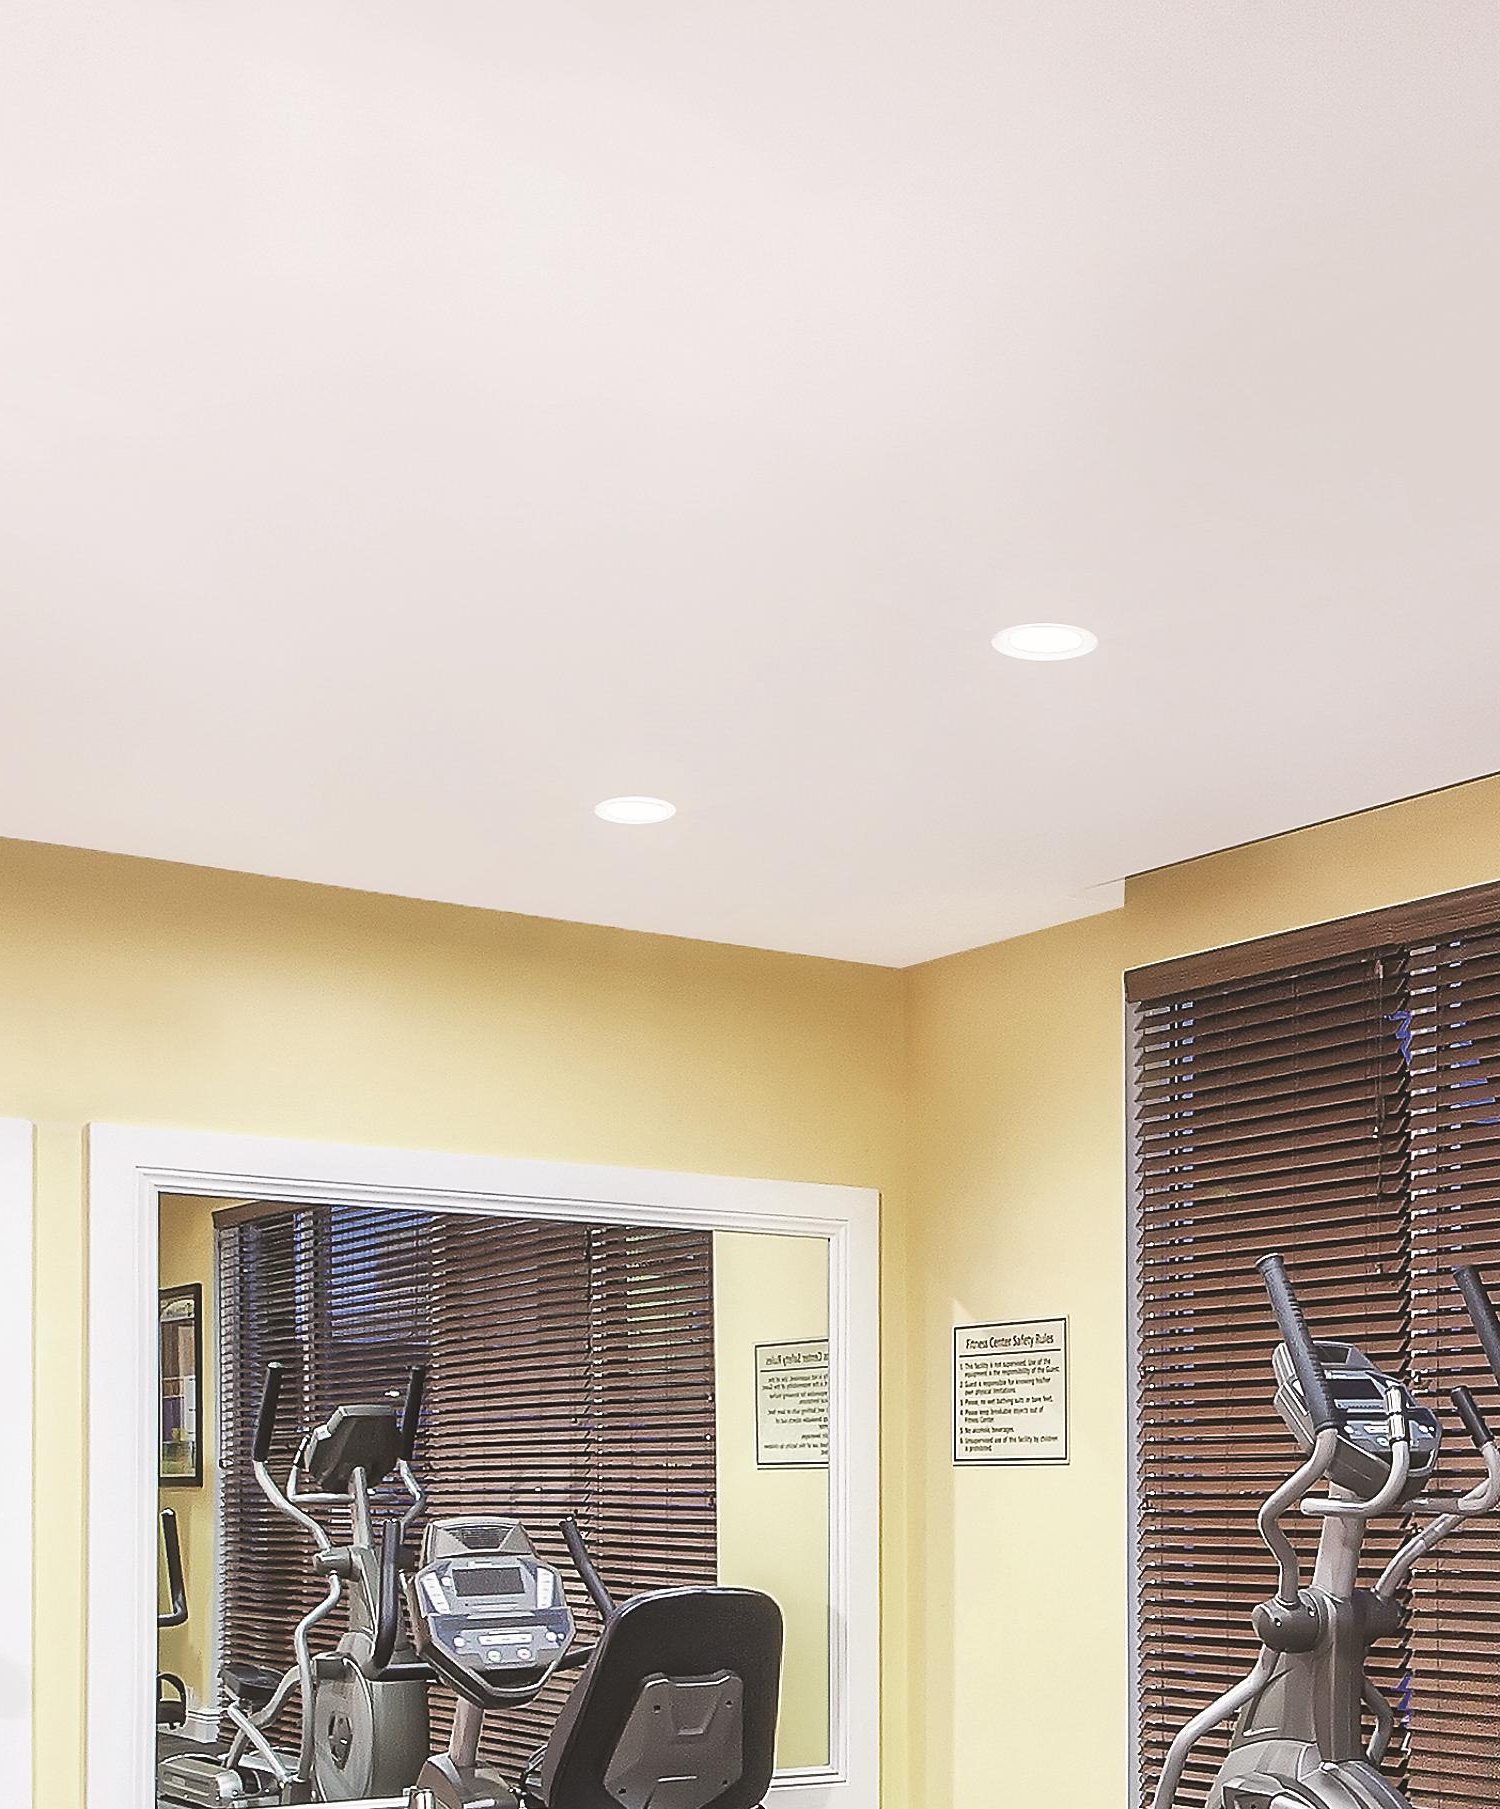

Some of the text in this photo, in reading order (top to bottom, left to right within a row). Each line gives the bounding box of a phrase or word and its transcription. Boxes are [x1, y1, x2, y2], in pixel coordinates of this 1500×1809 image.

[989, 1337, 1012, 1348] Center
[1013, 1334, 1034, 1348] Safety
[1035, 1333, 1054, 1344] Rules
